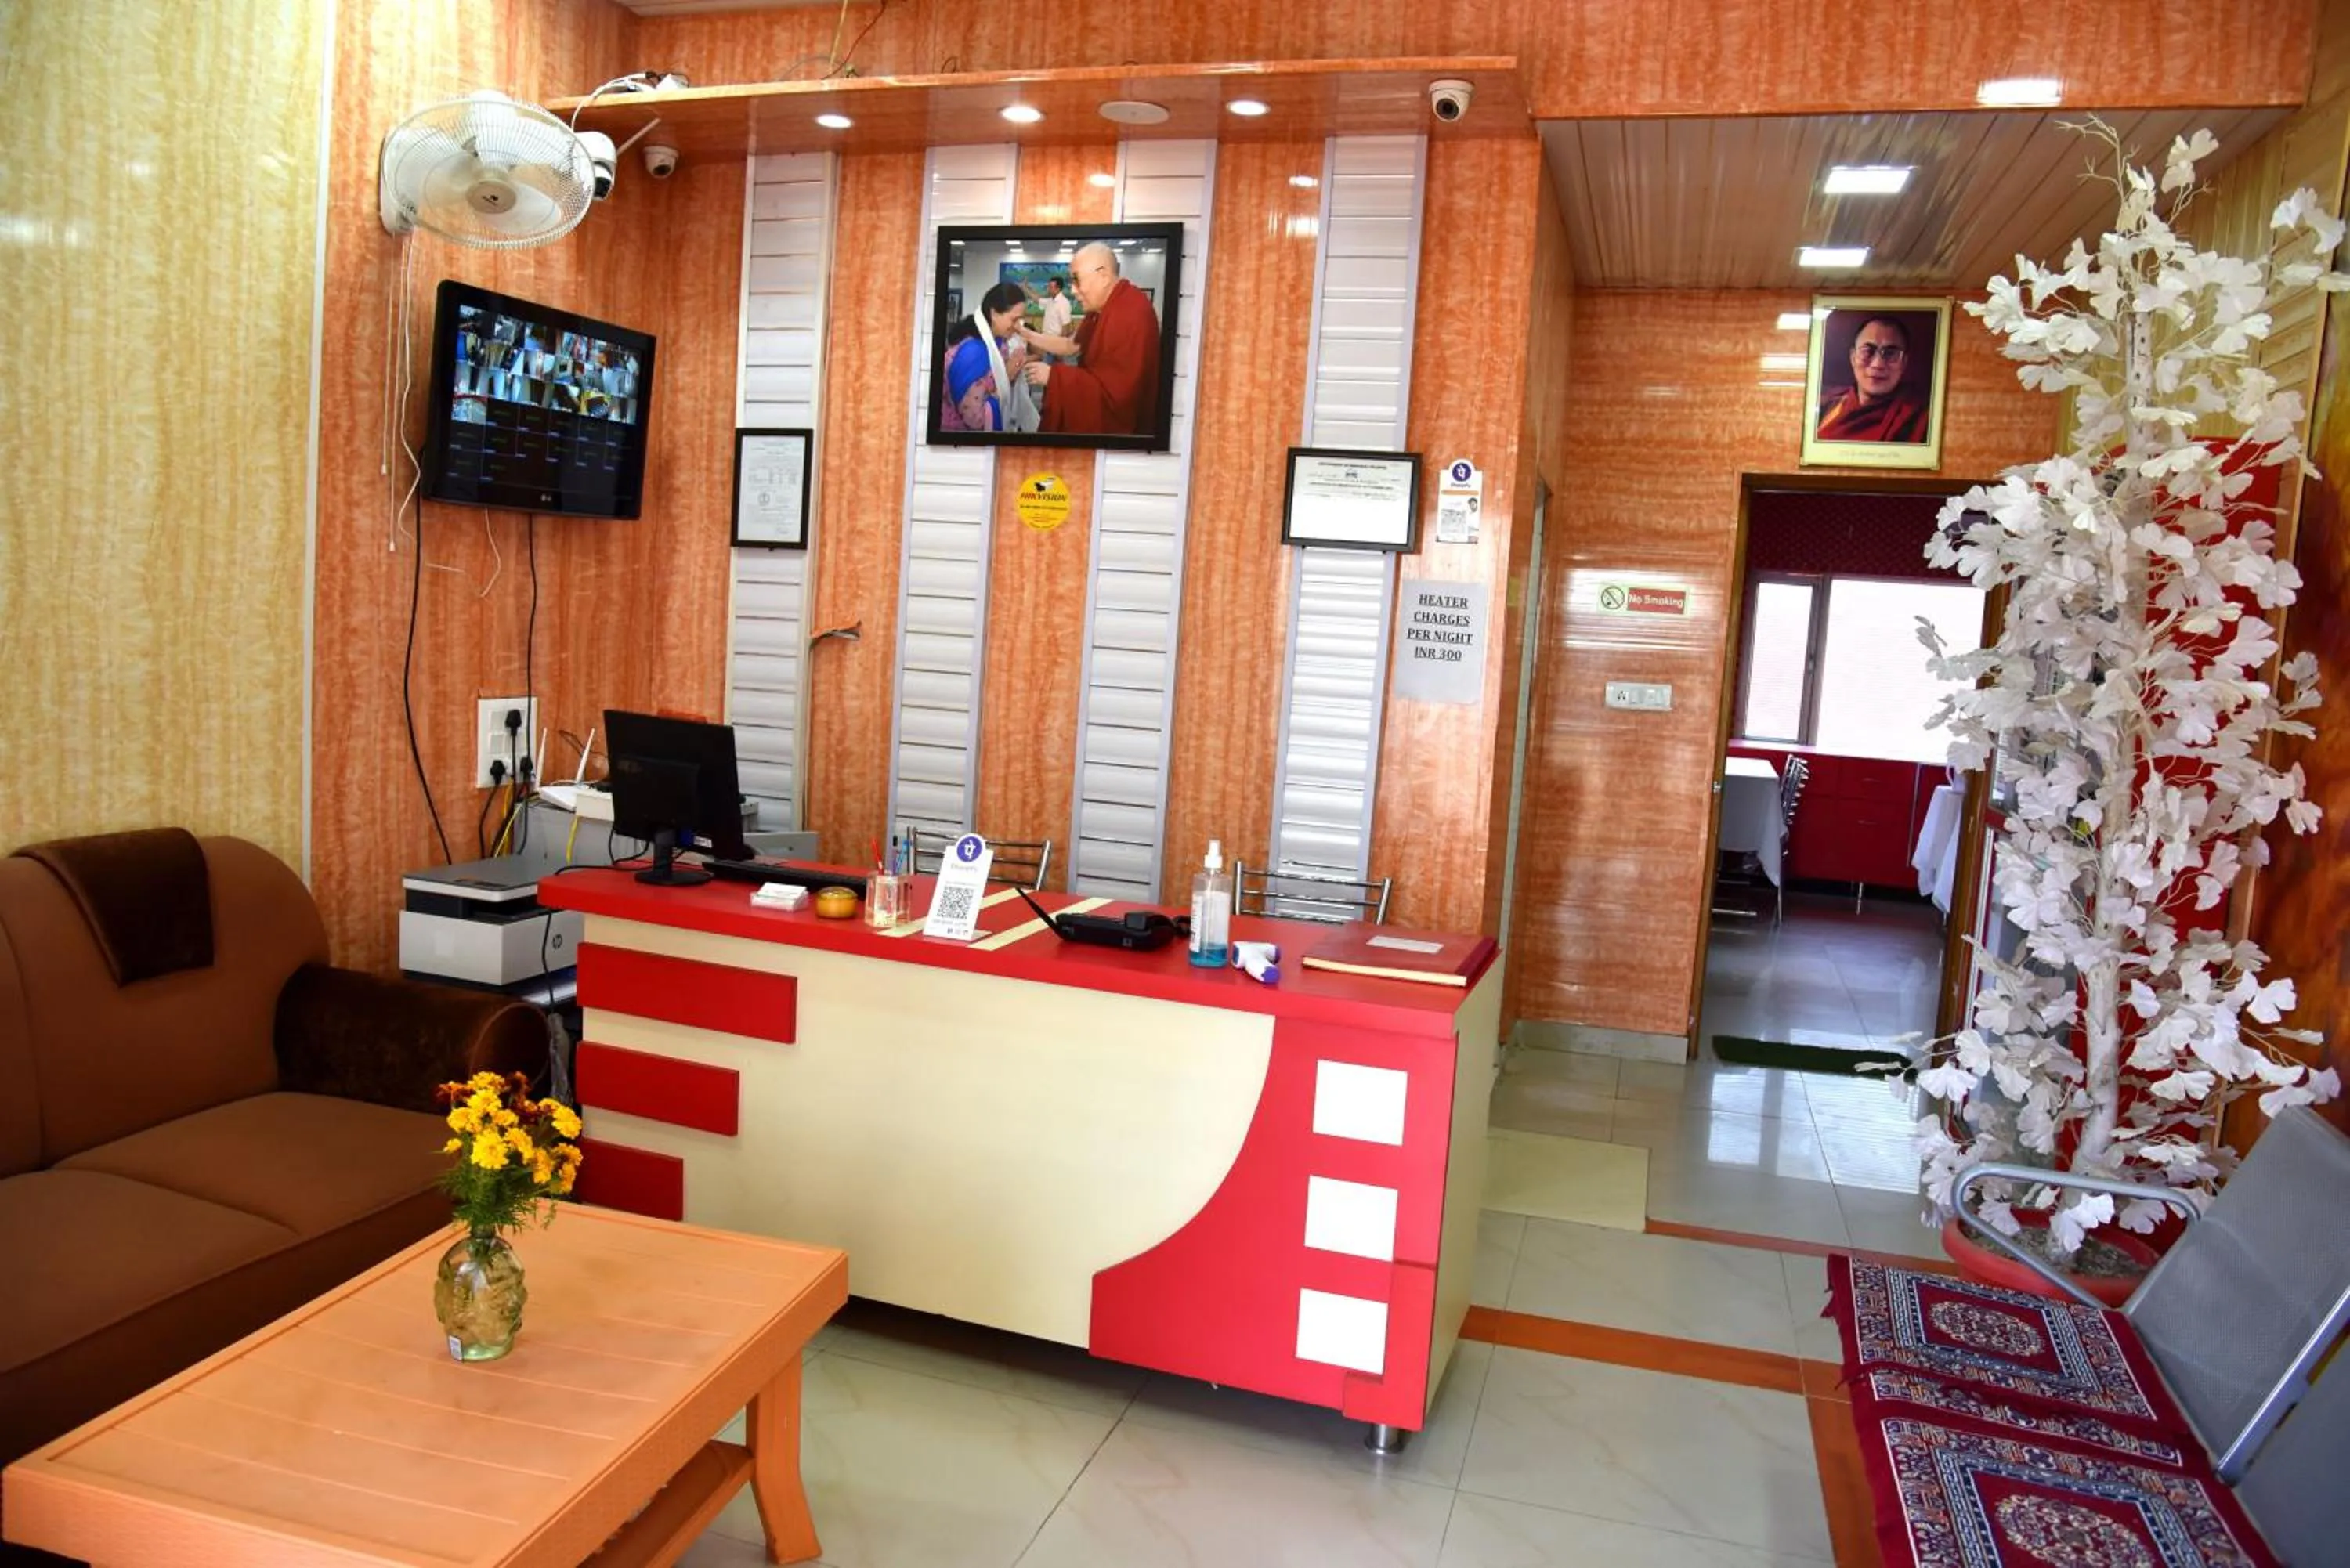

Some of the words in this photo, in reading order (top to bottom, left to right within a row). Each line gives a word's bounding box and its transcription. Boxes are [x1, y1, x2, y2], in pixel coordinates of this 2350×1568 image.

[1419, 594, 1468, 609] HEATER
[1629, 594, 1643, 604] No
[1644, 595, 1683, 609] Smoking
[1413, 611, 1470, 627] CHARGES
[1407, 627, 1431, 641] PER
[1434, 630, 1473, 645] NIGHT
[1414, 646, 1436, 659] INR
[1438, 648, 1462, 661] 300
